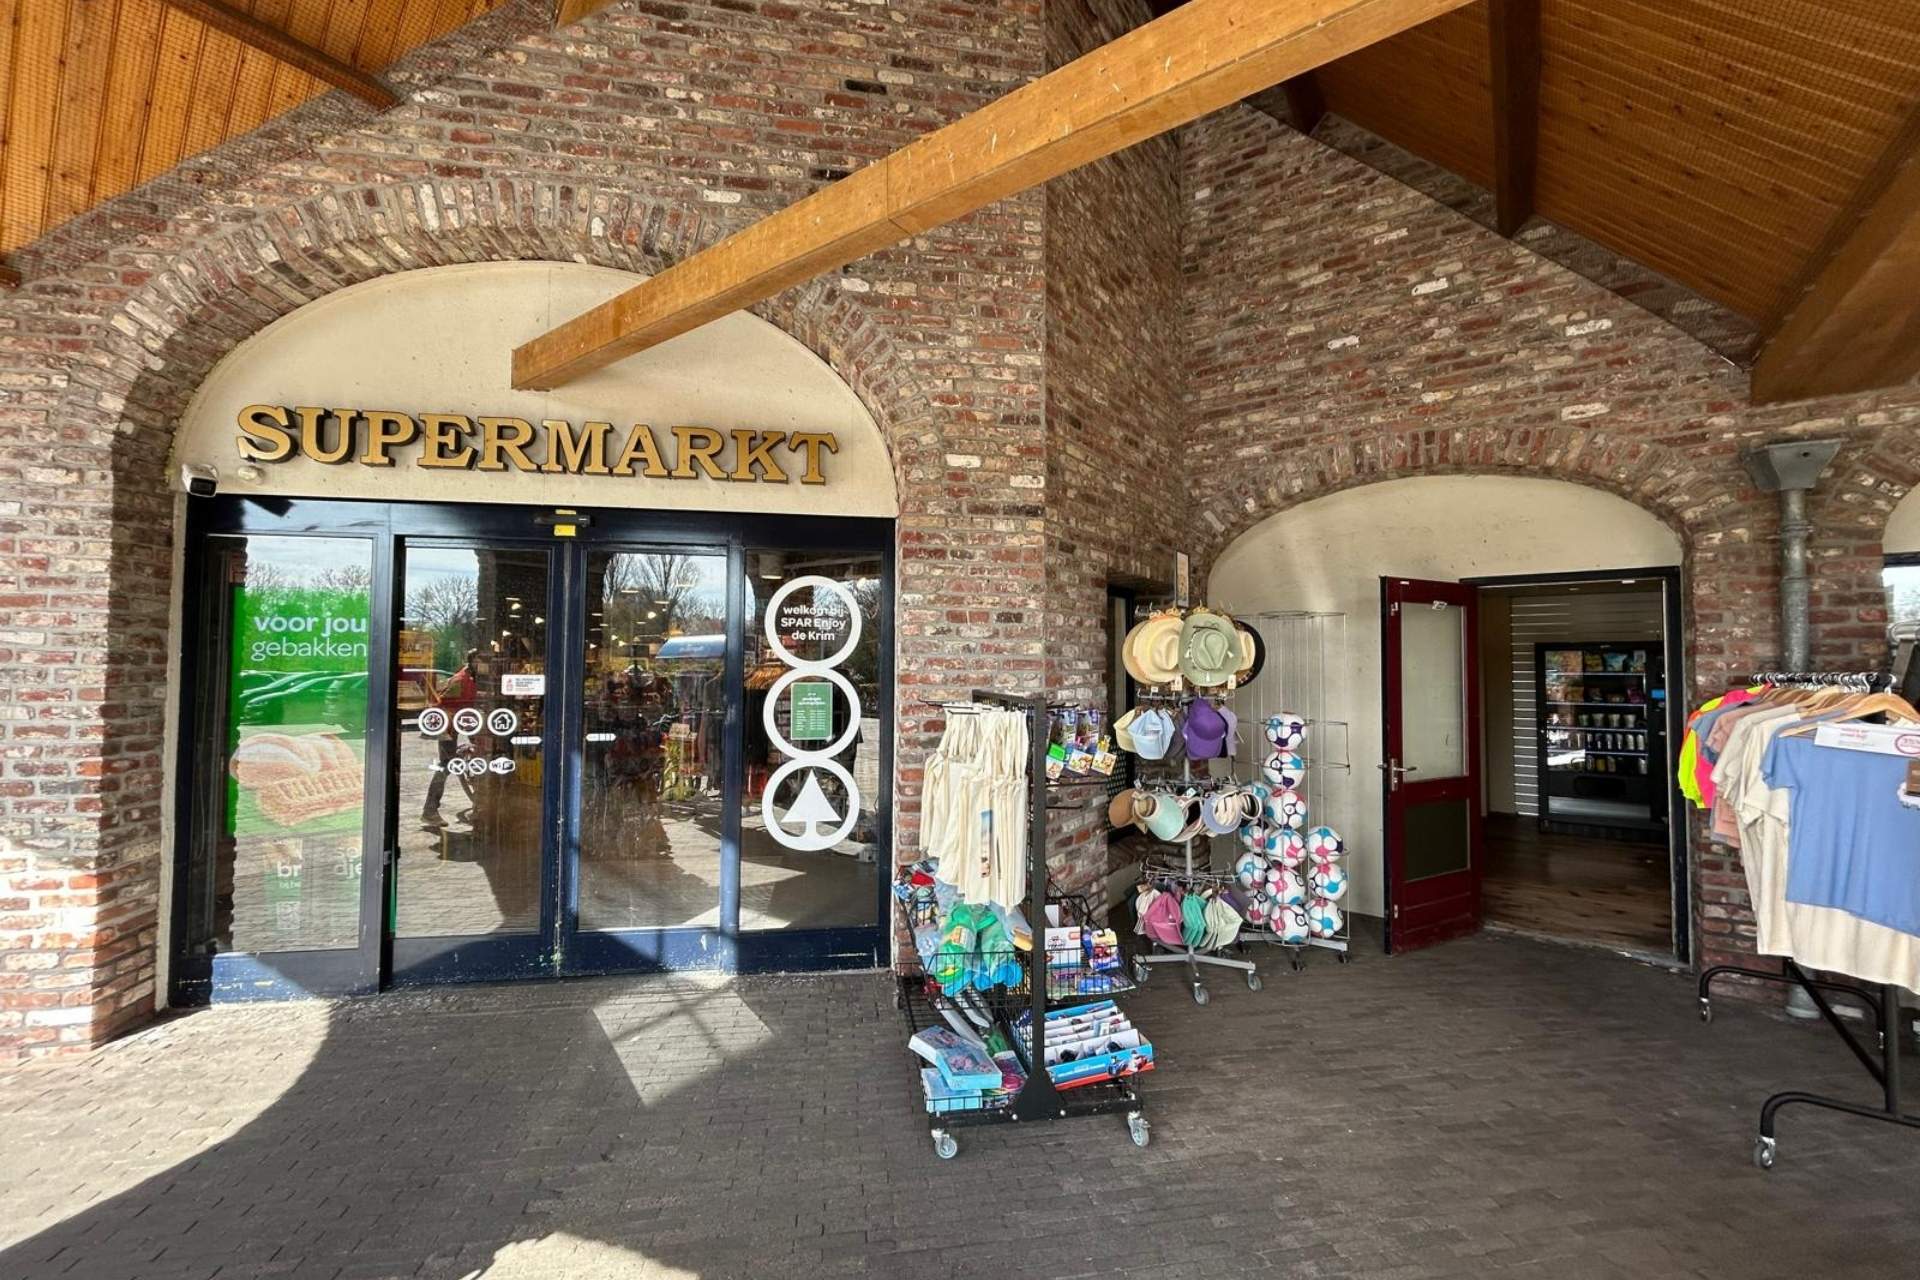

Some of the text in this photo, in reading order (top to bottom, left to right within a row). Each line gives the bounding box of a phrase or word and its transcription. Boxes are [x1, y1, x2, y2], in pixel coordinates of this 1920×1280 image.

[236, 404, 839, 485] SUPERMARKT
[783, 605, 829, 616] welkom
[254, 611, 366, 637] voor jou
[781, 617, 847, 630] SPAR Enjoy
[791, 630, 836, 641] de Krim
[251, 637, 367, 661] gebakken
